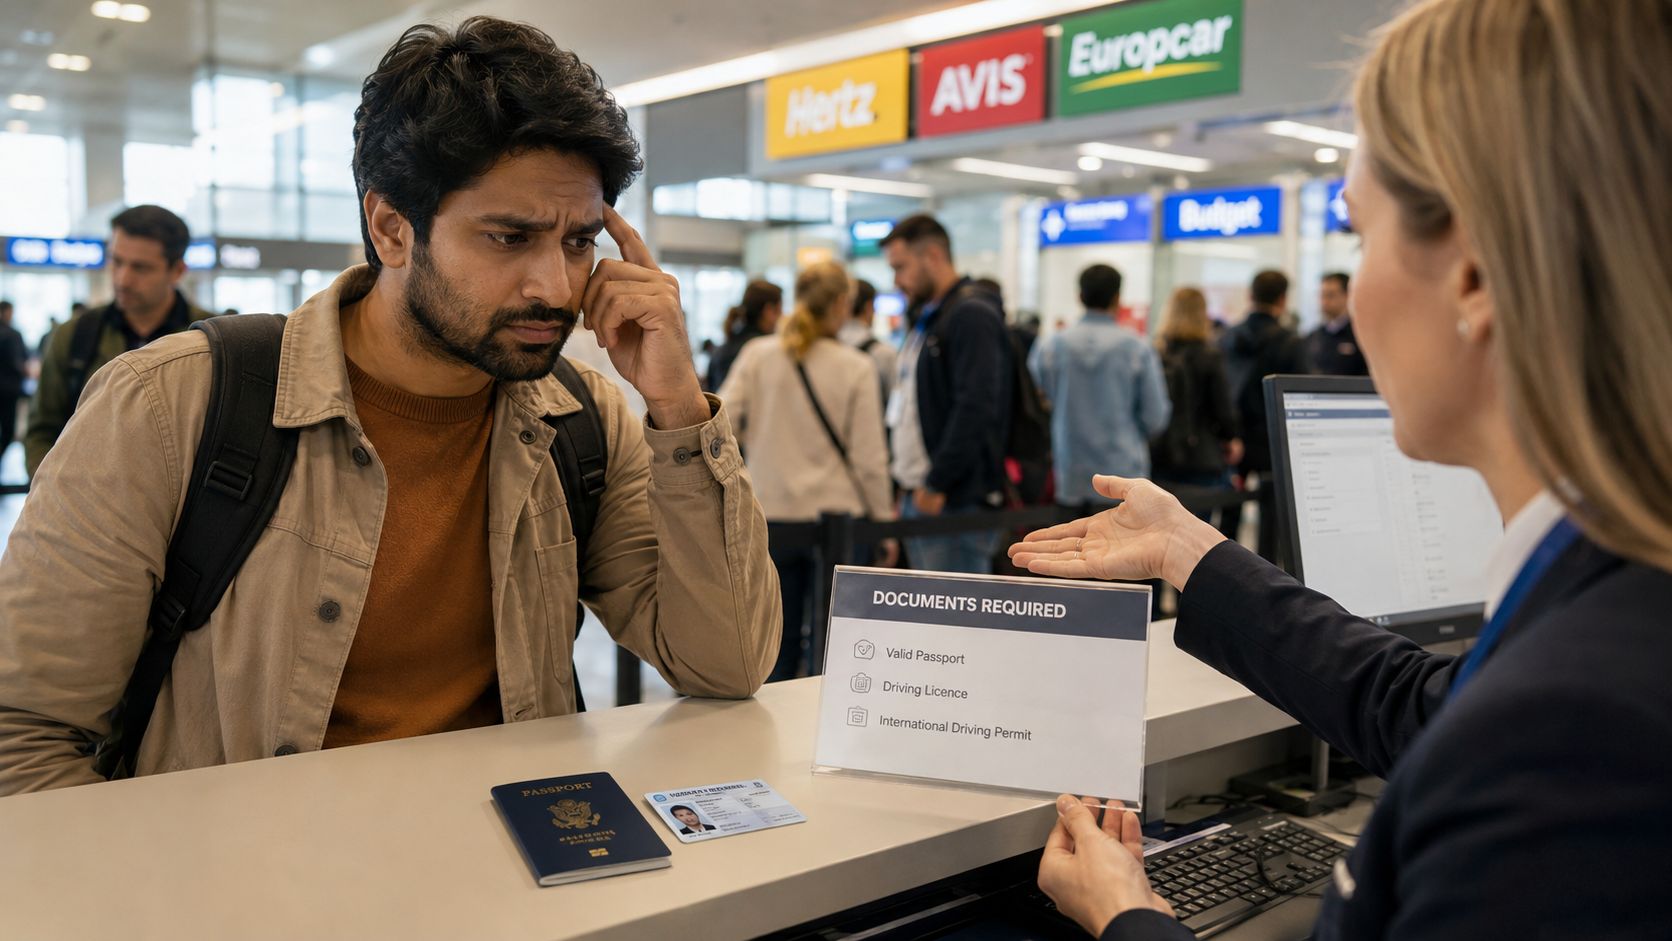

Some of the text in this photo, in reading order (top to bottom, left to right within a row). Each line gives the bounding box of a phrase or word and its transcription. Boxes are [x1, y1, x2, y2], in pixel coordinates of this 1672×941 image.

[1068, 15, 1233, 78] Europcar
[930, 53, 1027, 116] AVIS
[785, 76, 876, 138] Hertz
[1179, 196, 1262, 236] Budget
[873, 590, 1067, 619] DOCUMENTS REQUIRED
[886, 647, 965, 665] Valid Passport
[883, 681, 968, 699] Driving Licence
[879, 715, 1032, 741] International Driving Permit
[522, 782, 593, 797] PASSPORT
